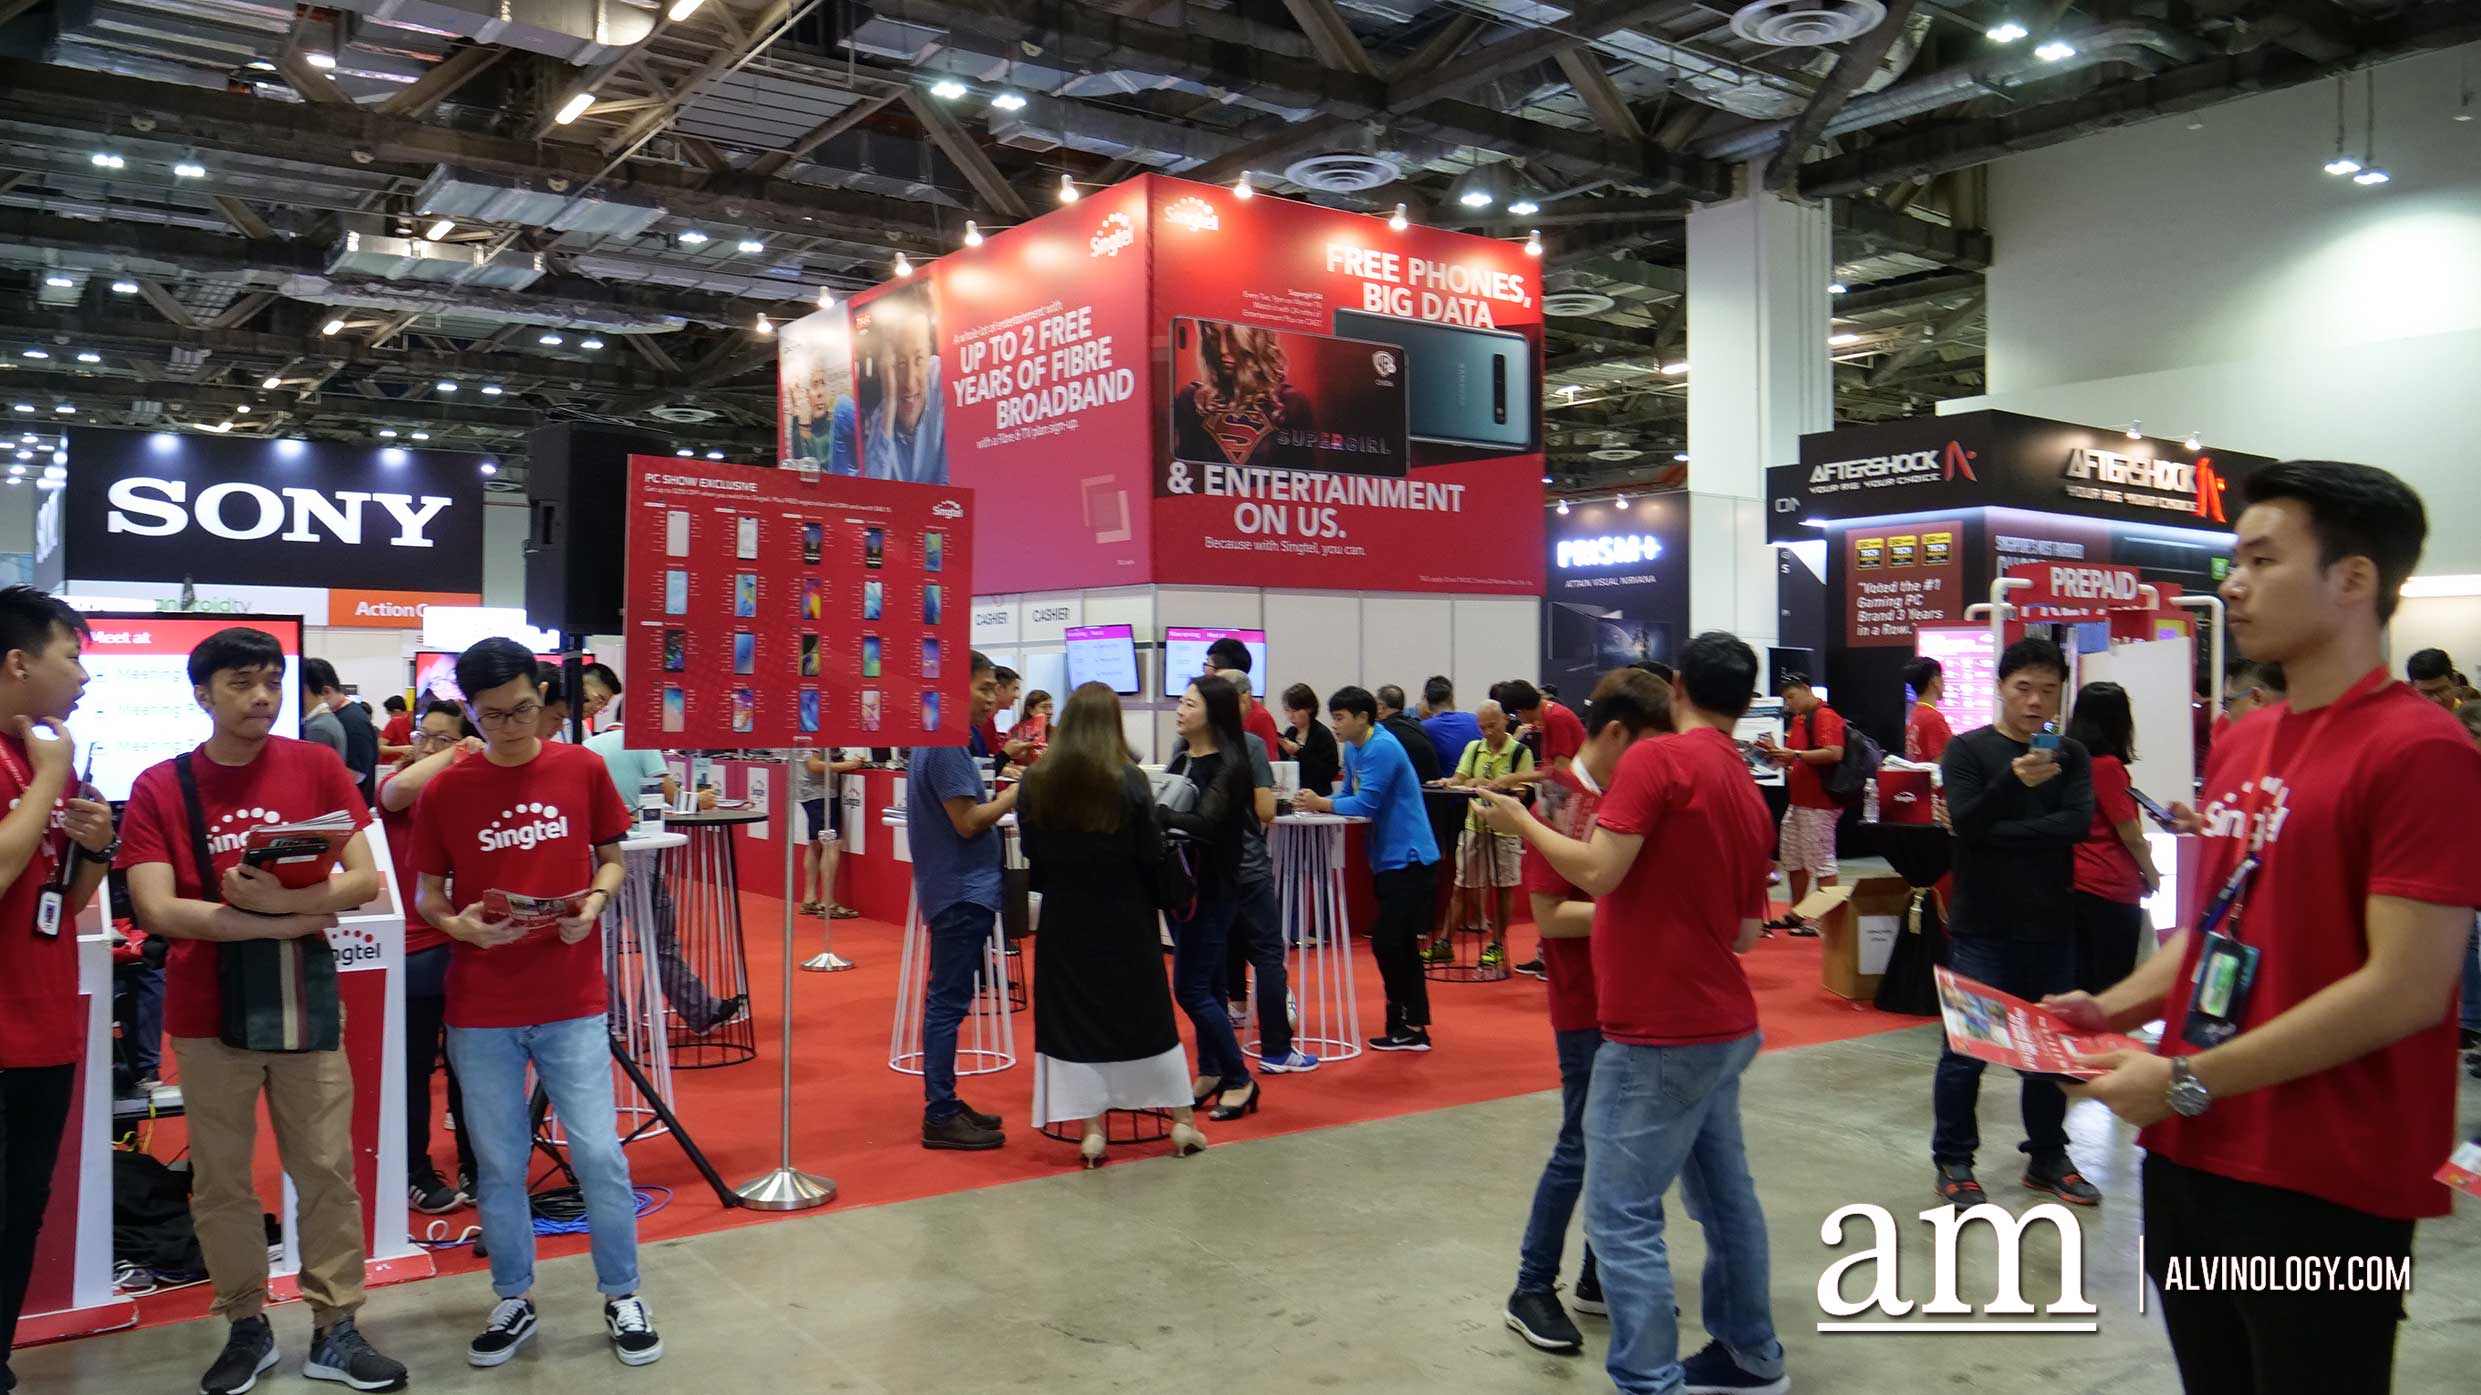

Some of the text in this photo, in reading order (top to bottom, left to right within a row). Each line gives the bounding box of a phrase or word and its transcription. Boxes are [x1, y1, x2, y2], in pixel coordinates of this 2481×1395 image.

[1326, 242, 1532, 308] FREE PHONES,
[1363, 282, 1413, 317] BIG
[1421, 292, 1495, 329] DATA
[960, 306, 1092, 374] UP TO 2 FREE
[953, 336, 1112, 407] YEARS OF FIBRE
[996, 368, 1135, 429] BROADBAND
[1277, 428, 1392, 456] SUPERGIRL
[1809, 450, 1941, 483] AFTERSHOCK
[2065, 448, 2198, 494] AFTERSHOCK
[662, 474, 698, 487] SHOW
[699, 478, 758, 493] EXCLUSIVE
[1167, 461, 1465, 512] & ENTERTAINMENT
[1809, 484, 1839, 494] YOUR
[1864, 478, 1895, 488] YOUR
[1896, 473, 1941, 485] CHOICE
[107, 477, 453, 547] SONY
[1234, 502, 1347, 538] ON US.
[1205, 536, 1252, 551] Because
[1253, 539, 1279, 552] with
[1321, 543, 1343, 557] you
[1900, 580, 1921, 592] the
[1923, 578, 1941, 590] #1
[2050, 567, 2138, 601] PREPAID
[1032, 606, 1070, 622] CASHIER
[1856, 594, 1924, 609] Gaming PC
[1857, 608, 1944, 622] Brand 3 Years
[975, 611, 1009, 626] CASHIER
[1857, 624, 1870, 636] in
[1871, 626, 1880, 636] a
[478, 816, 568, 852] Singtel
[333, 943, 382, 965] ngtel
